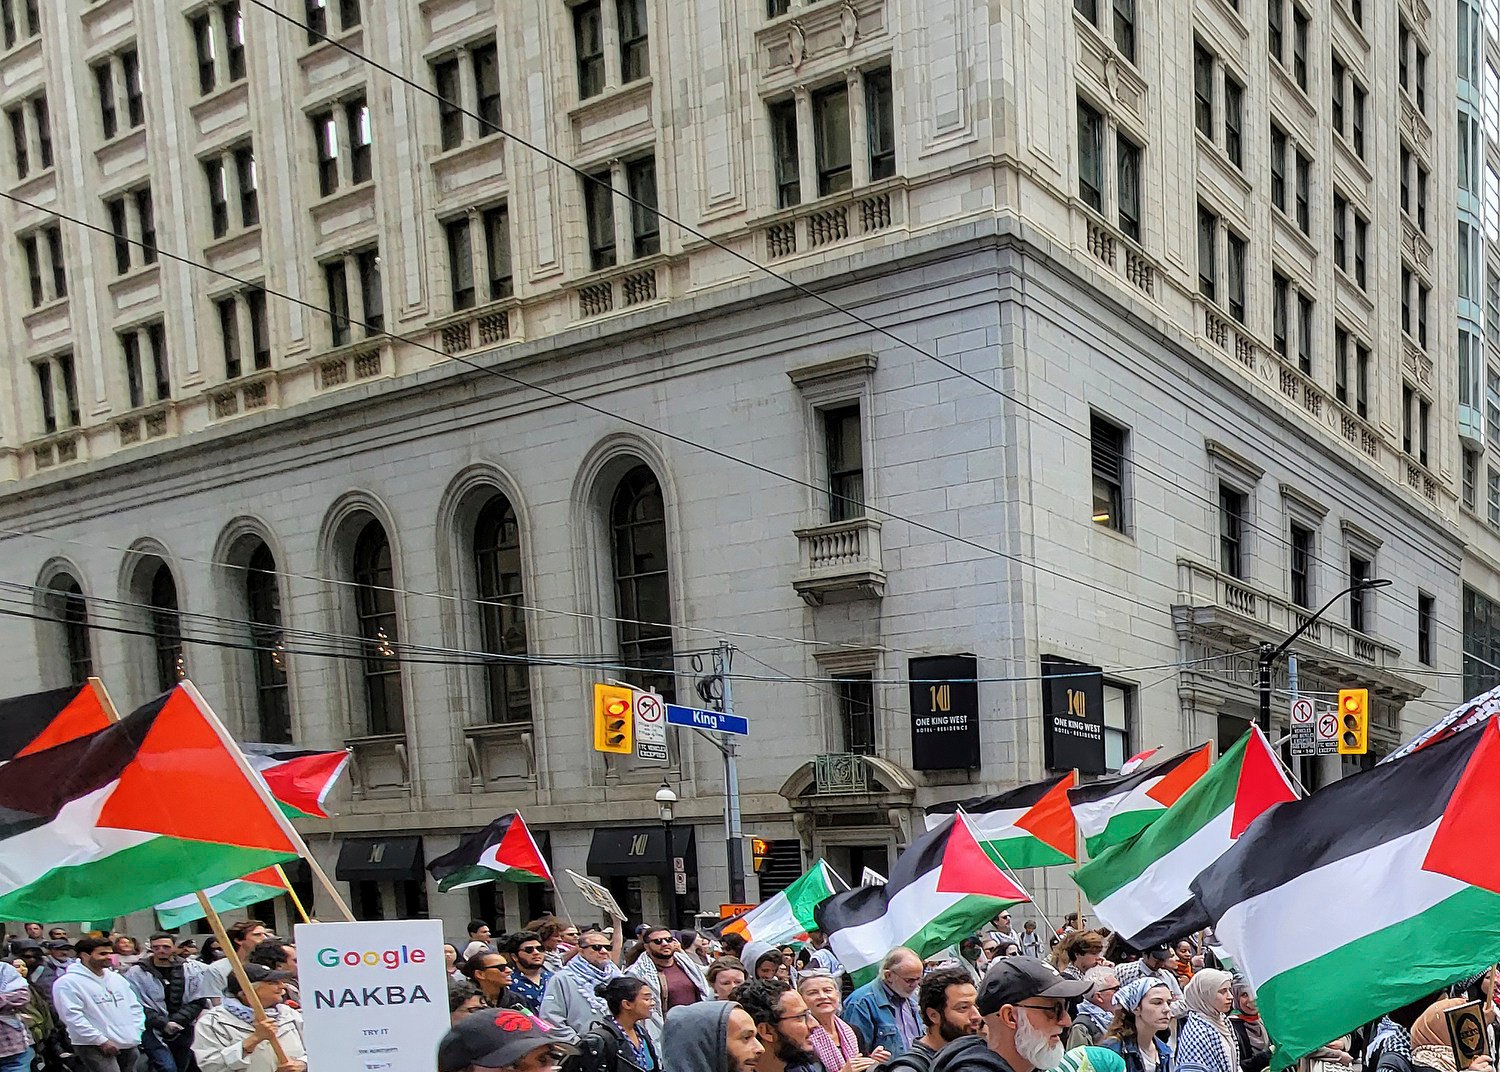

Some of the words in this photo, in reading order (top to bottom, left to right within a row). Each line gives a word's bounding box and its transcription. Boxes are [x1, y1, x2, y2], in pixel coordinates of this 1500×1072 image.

[693, 711, 718, 728] King
[916, 718, 930, 726] ONE
[931, 716, 949, 725] KING
[950, 715, 967, 724] WEST
[1054, 717, 1067, 727] ONE
[1068, 720, 1084, 730] KING
[1084, 722, 1100, 733] WEST
[317, 945, 426, 969] Google
[314, 985, 431, 1009] NAKBA
